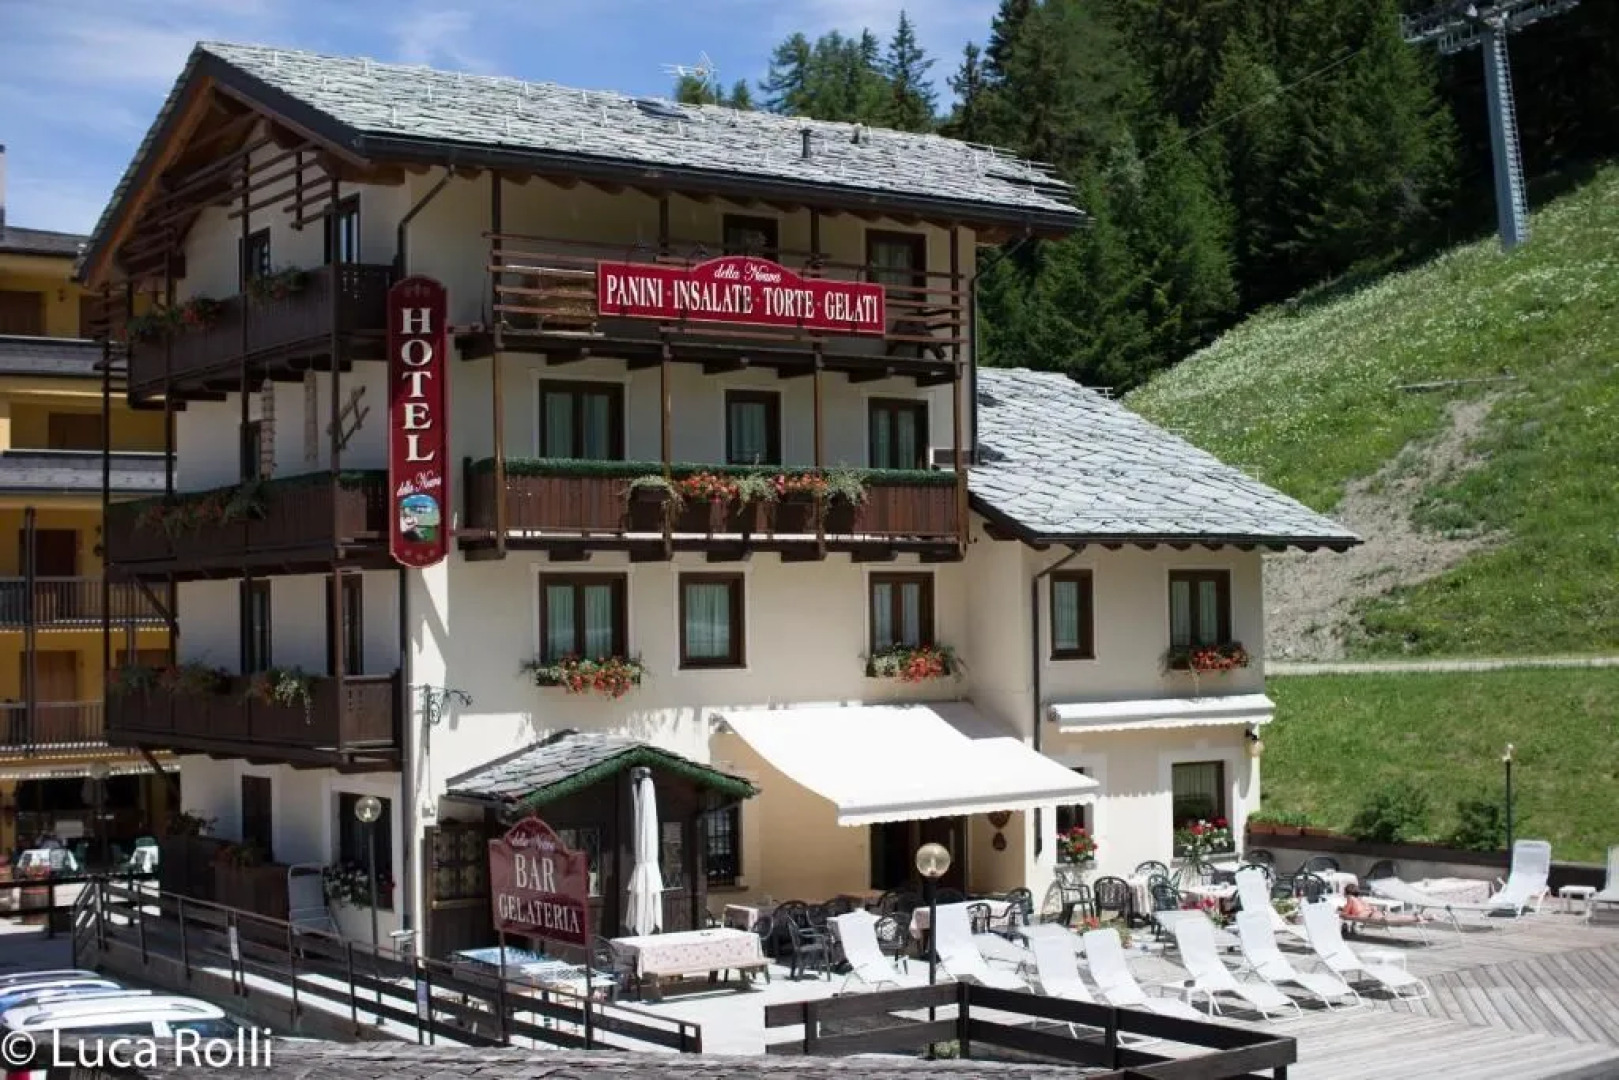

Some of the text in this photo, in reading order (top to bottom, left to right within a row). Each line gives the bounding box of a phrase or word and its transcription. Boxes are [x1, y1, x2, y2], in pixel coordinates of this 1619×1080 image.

[714, 263, 740, 279] della
[606, 274, 878, 323] PANINI INSALATE TORTE GELATI
[401, 307, 435, 461] HOTEL
[514, 853, 556, 894] BAR
[498, 892, 581, 934] GELATERIA
